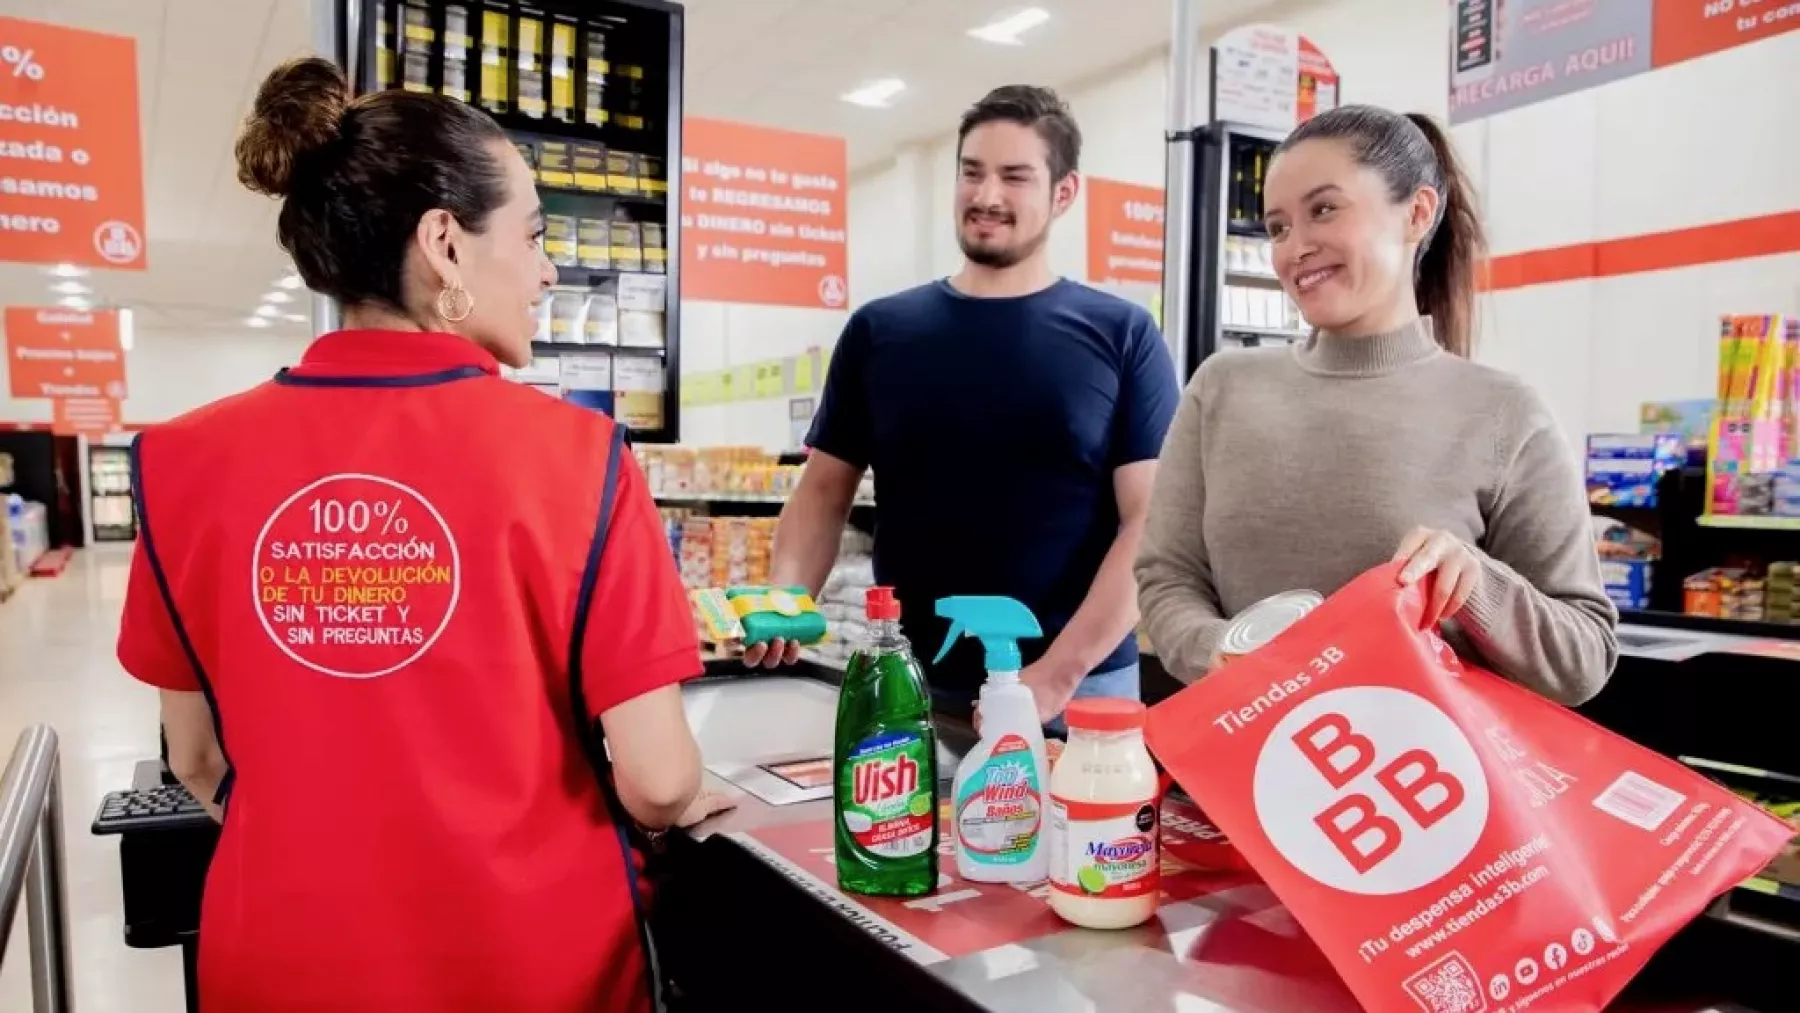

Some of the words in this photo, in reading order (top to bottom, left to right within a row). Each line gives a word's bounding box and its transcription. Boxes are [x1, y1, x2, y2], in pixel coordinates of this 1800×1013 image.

[1704, 0, 1733, 18] NO
[1737, 16, 1757, 31] tu
[71, 148, 90, 165] o
[703, 160, 741, 180] algo
[745, 167, 766, 181] no
[770, 168, 788, 185] te
[792, 173, 838, 191] gusta
[689, 186, 707, 202] te
[711, 188, 831, 215] REGRESAMOS
[697, 214, 766, 235] DINERO
[770, 222, 795, 238] sin
[799, 225, 845, 243] ticket
[697, 244, 708, 261] y
[711, 244, 738, 260] sin
[742, 247, 827, 267] preguntas
[309, 499, 408, 535] 100%
[271, 536, 435, 560] SATISFACCIÓN
[260, 566, 275, 583] O
[285, 566, 311, 584] LA
[322, 561, 450, 584] DEVOLUCIÓN
[263, 587, 288, 603] DE
[301, 587, 324, 603] TU
[334, 587, 406, 604] DINERO
[273, 606, 304, 622] SIN
[316, 605, 386, 623] TICKET
[398, 606, 410, 623] Y
[288, 628, 313, 644] SIN
[323, 627, 423, 645] PREGUNTAS
[1212, 669, 1312, 736] Tiendas
[1309, 645, 1345, 675] 3B
[853, 752, 919, 804] Vish
[984, 781, 1029, 803] Wind
[1358, 935, 1389, 965] ¡Tu
[1388, 881, 1474, 944] despensa
[1404, 864, 1549, 959] www.tiendas3b.com
